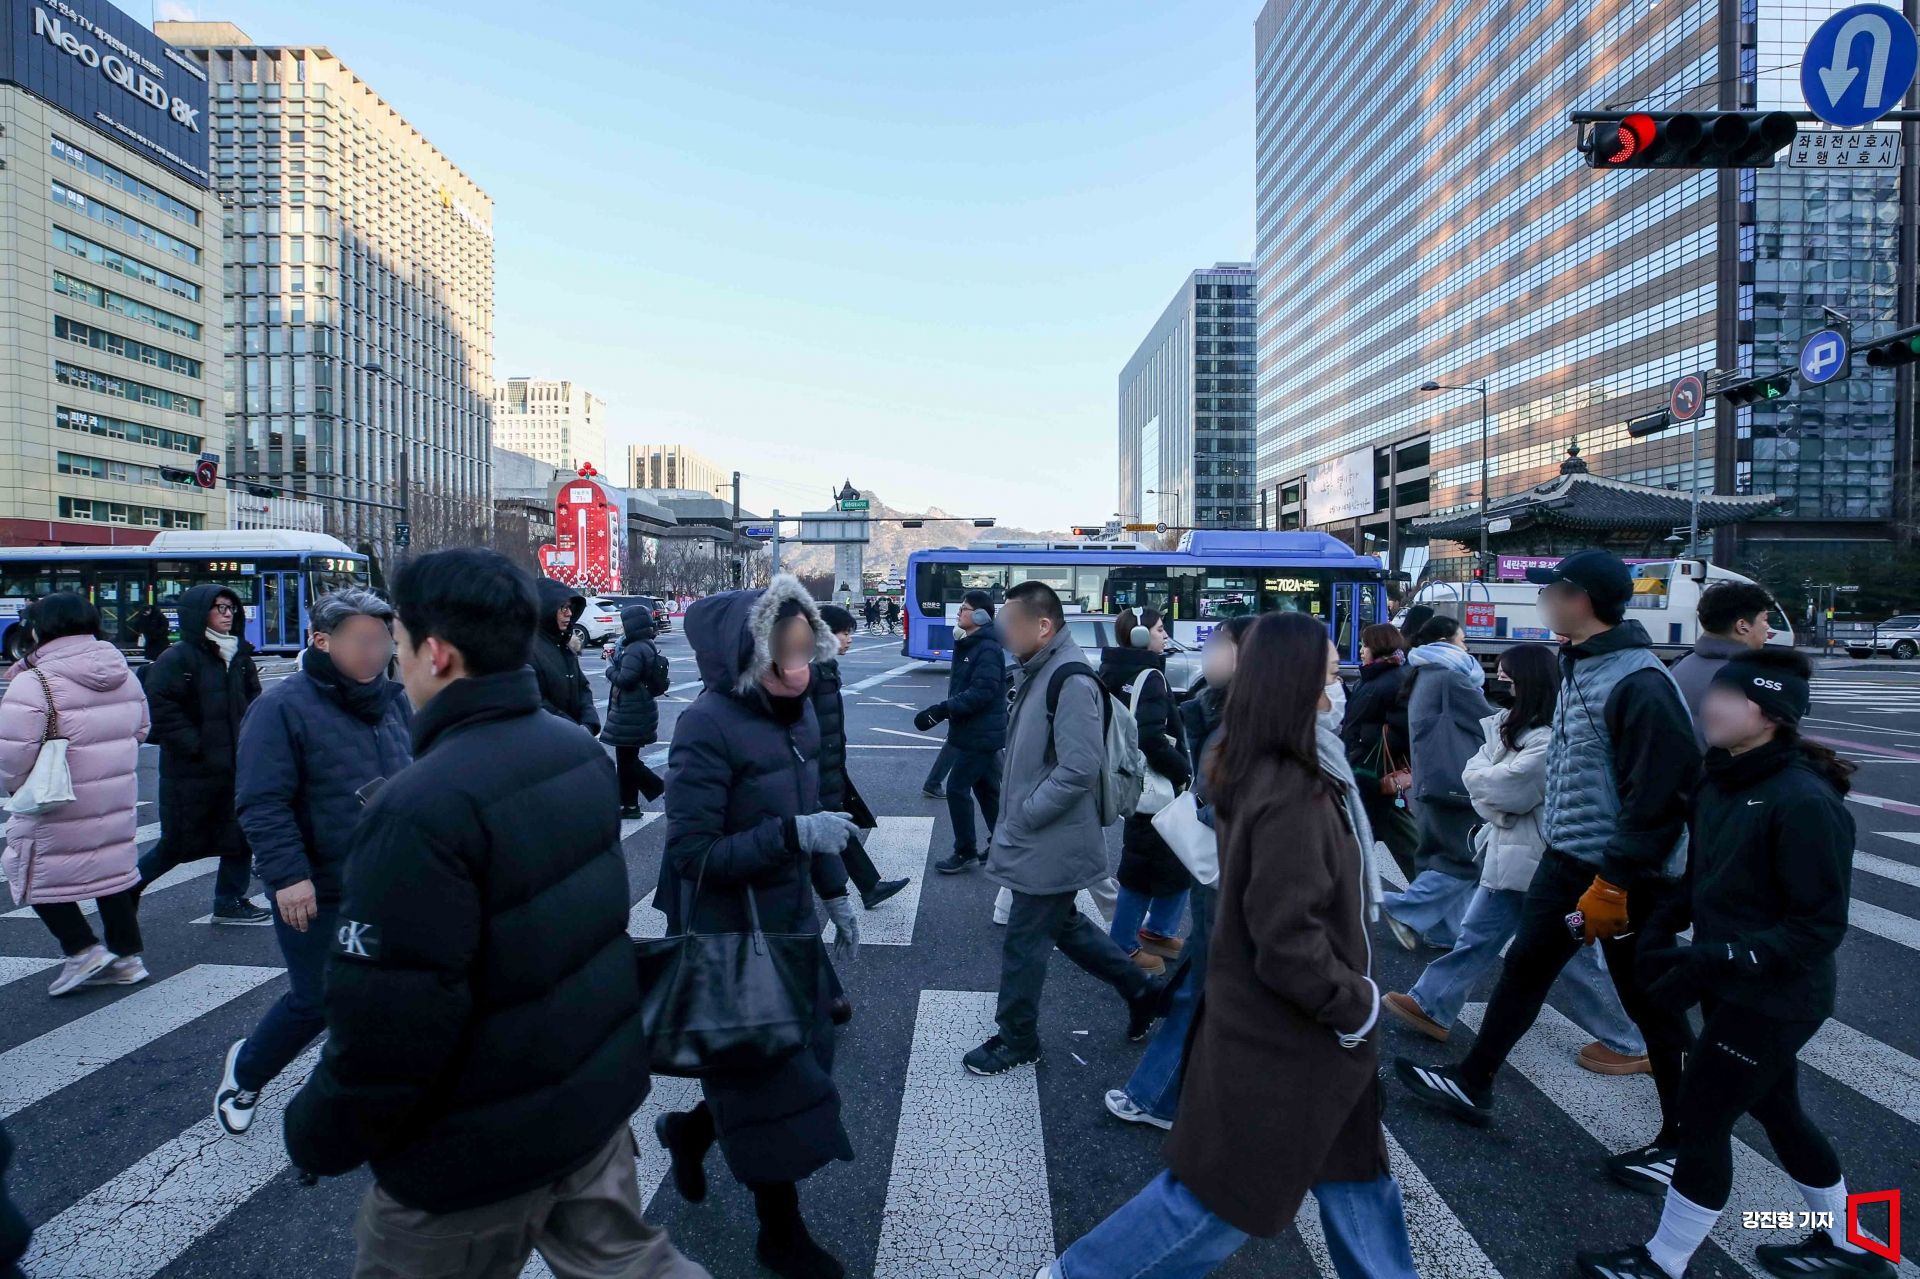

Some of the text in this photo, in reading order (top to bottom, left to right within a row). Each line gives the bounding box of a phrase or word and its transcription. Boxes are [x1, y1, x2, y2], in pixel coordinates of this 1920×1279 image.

[58, 2, 77, 22] 연속
[78, 15, 93, 31] TV
[128, 48, 140, 65] 1위
[141, 57, 164, 80] 브랜드
[35, 7, 200, 133] Neo QLED 8K
[1799, 134, 1894, 149] 좌회전신호시
[1796, 150, 1891, 165] 보행신호시
[71, 411, 98, 427] 피부과
[209, 561, 238, 572] 370
[328, 558, 355, 572] 370
[1277, 578, 1301, 592] 702A
[1753, 677, 1783, 691] OSS
